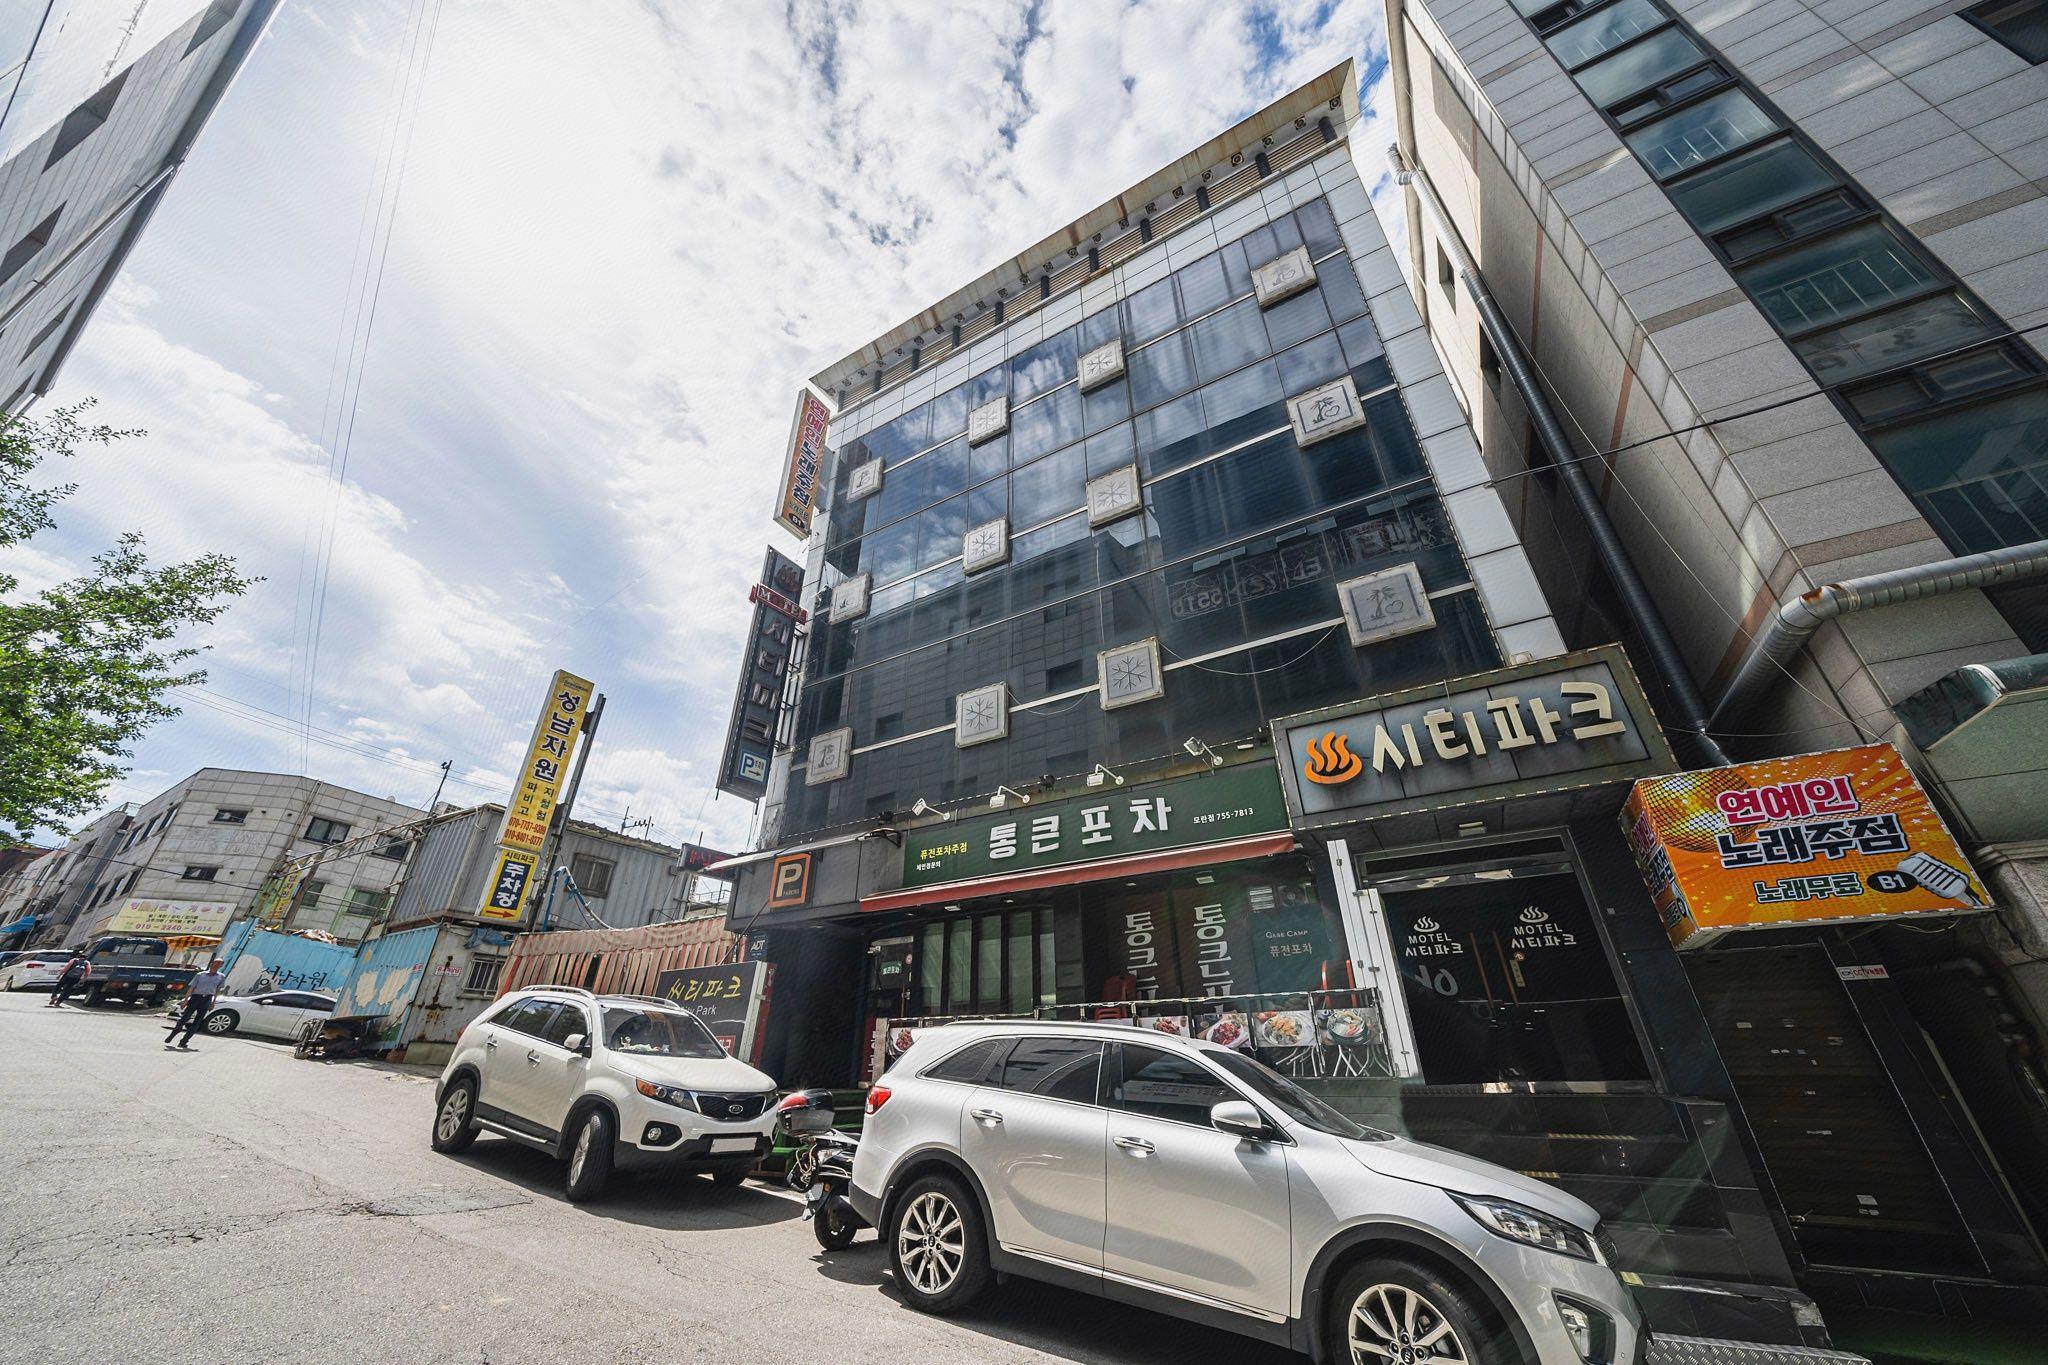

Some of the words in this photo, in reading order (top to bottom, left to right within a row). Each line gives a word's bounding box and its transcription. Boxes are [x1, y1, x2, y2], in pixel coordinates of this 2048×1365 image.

[534, 691, 581, 783] 성남자원
[1373, 682, 1626, 774] 시티파크
[742, 755, 754, 774] P
[1717, 776, 1858, 825] 연예인
[1193, 813, 1215, 824] 모란점
[1217, 808, 1254, 820] 755-7813
[990, 798, 1172, 859] 통큰포차
[1716, 814, 1909, 868] 노래주점
[920, 842, 968, 860] 퓨전포차주점
[496, 862, 526, 907] 주차장
[776, 862, 803, 898] P
[1754, 872, 1864, 903] 노래무료
[1877, 874, 1907, 891] B1
[1408, 932, 1453, 945] MOTEL
[1514, 923, 1563, 936] MOTEL
[751, 940, 765, 953] ADT
[1269, 943, 1313, 958] 퓨전포차
[1405, 942, 1464, 957] 시티파크
[1511, 934, 1577, 949] 시티파크
[259, 966, 328, 992] 성남자원
[696, 1005, 717, 1016] Park
